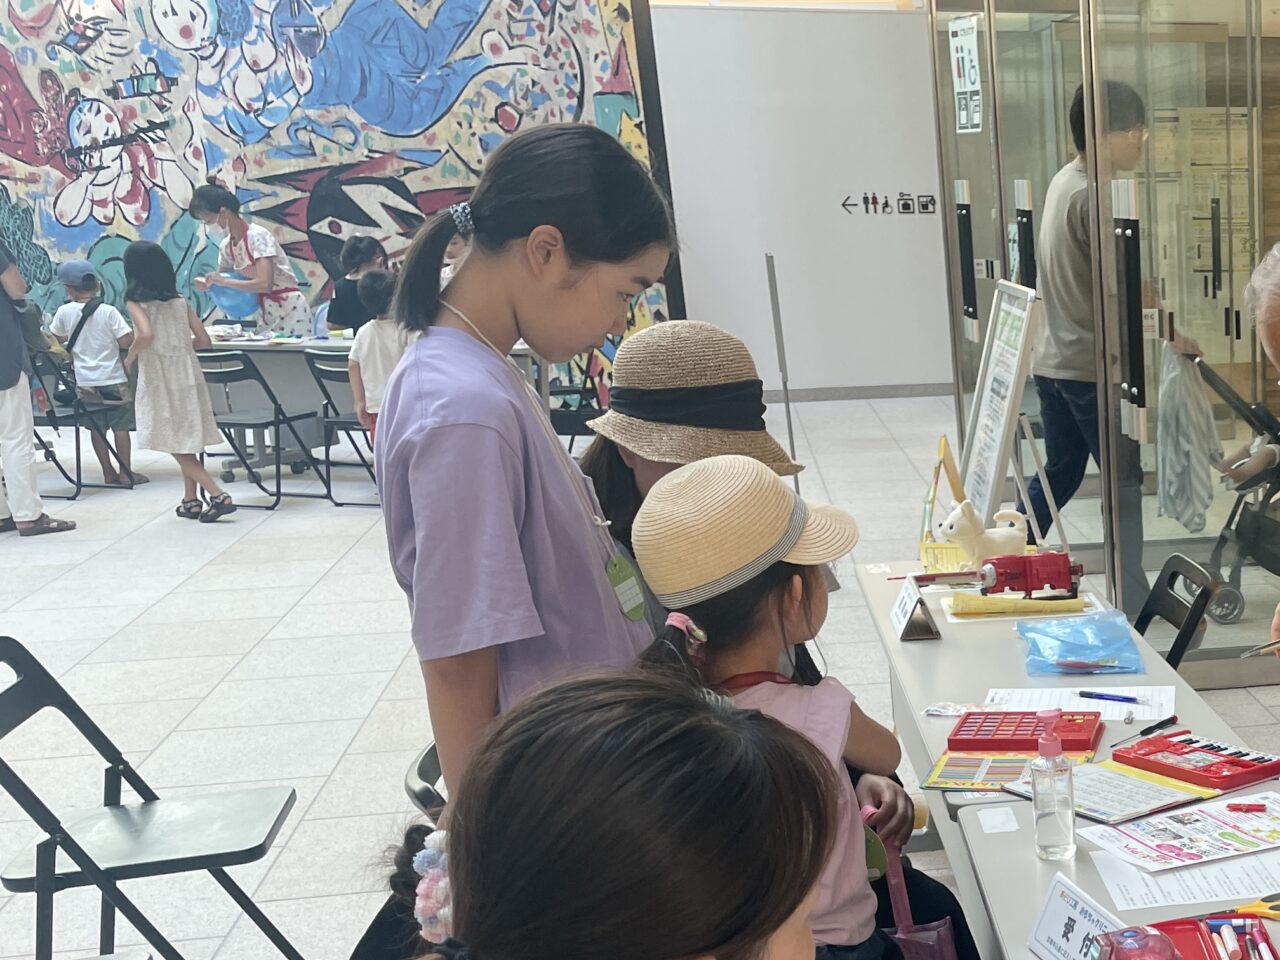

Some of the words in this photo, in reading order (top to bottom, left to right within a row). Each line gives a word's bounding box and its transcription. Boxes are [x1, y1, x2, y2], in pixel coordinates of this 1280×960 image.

[1062, 916, 1095, 959] 受付
[1079, 906, 1109, 934] おもちゃクリニ
